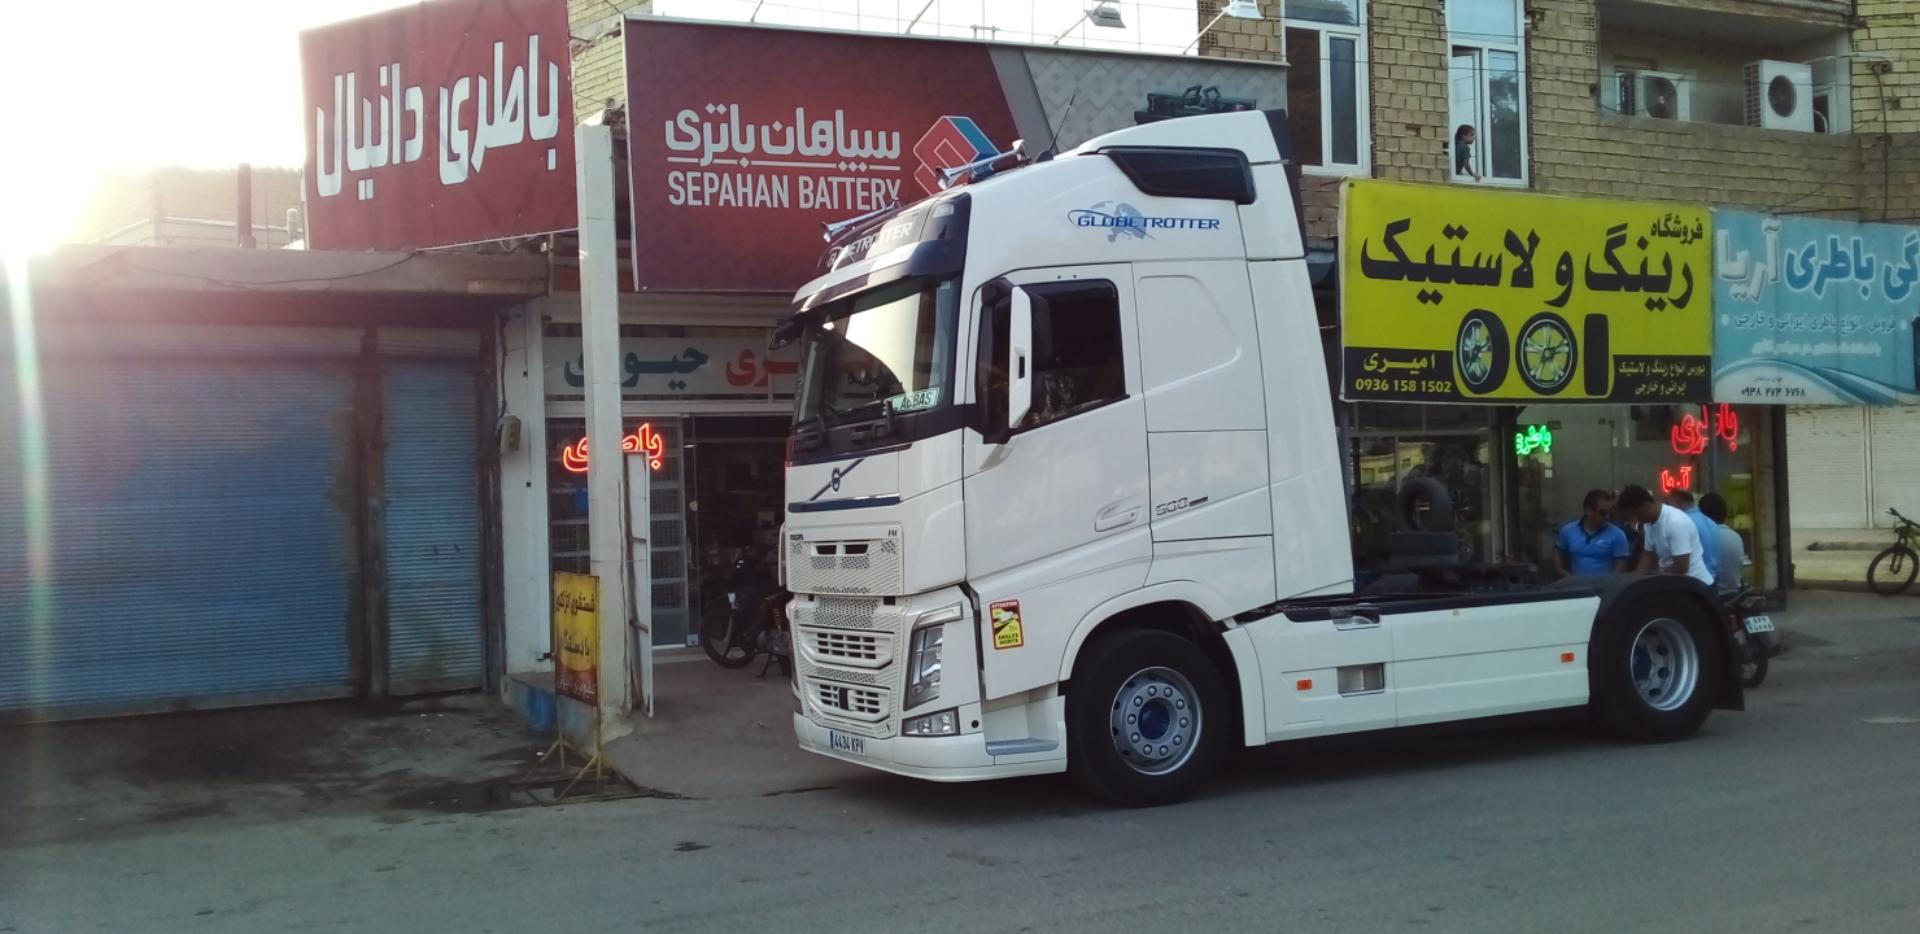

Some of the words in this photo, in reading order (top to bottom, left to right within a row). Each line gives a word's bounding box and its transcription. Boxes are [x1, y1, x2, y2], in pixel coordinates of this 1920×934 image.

[316, 62, 424, 200] دانیال
[440, 34, 559, 185] باطری
[665, 103, 755, 168] باتری
[761, 106, 900, 173] سپاهان
[667, 171, 789, 208] SEPAHAN
[800, 175, 900, 211] BATTERY
[1077, 214, 1220, 230] GLOBETROTTER
[1651, 213, 1703, 244] فروشگاه
[1717, 218, 1782, 303] آریا
[1360, 218, 1541, 306] لاستیک
[1544, 250, 1574, 308] و
[1585, 222, 1693, 311] رینگ
[1784, 234, 1876, 300] باطری
[1355, 378, 1389, 391] 0936
[1393, 379, 1416, 392] 158
[1421, 381, 1452, 393] 1502
[1363, 352, 1437, 375] امیری
